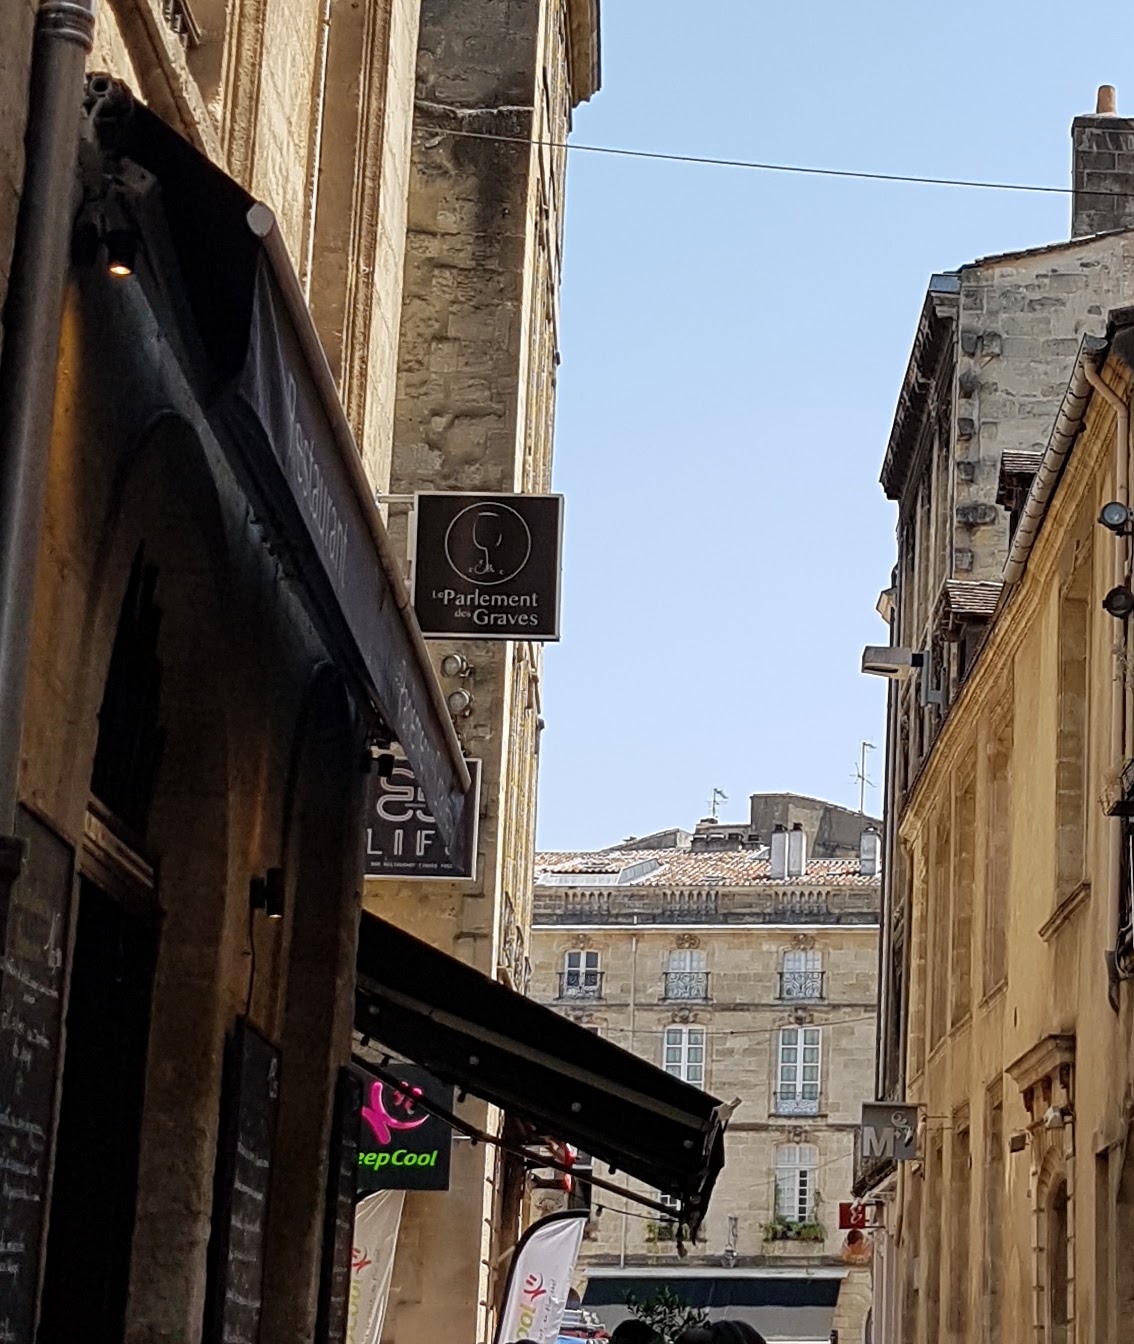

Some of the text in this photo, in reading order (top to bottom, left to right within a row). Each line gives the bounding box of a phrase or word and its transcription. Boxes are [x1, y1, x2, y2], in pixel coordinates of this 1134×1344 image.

[288, 371, 349, 586] Restaurant
[432, 588, 538, 607] Le Parlement
[453, 608, 539, 626] des Graves
[358, 1149, 439, 1171] eepCool
